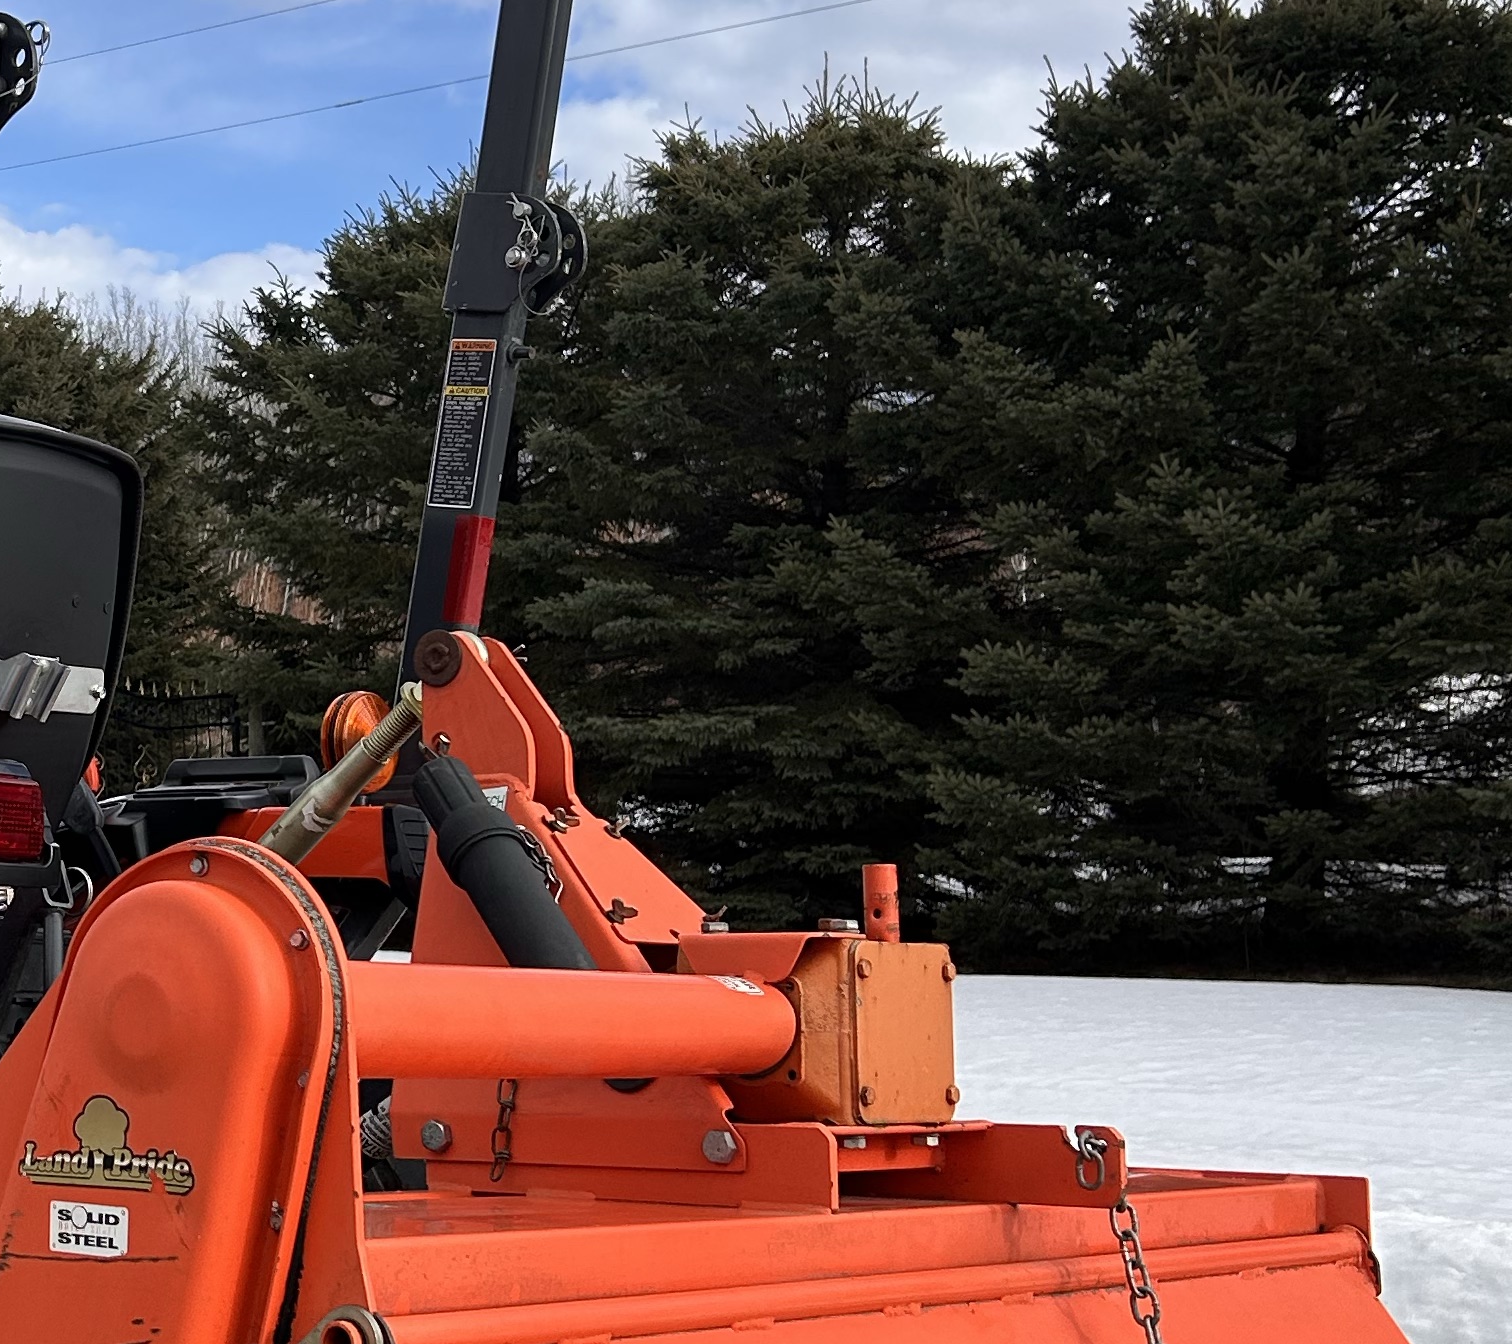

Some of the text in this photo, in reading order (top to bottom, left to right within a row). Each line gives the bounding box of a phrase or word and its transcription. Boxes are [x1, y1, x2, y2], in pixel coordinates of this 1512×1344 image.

[455, 387, 486, 395] CAUTION
[21, 1141, 191, 1183] Land Pride
[57, 1206, 120, 1229] SOLID
[57, 1232, 119, 1250] STEEL
